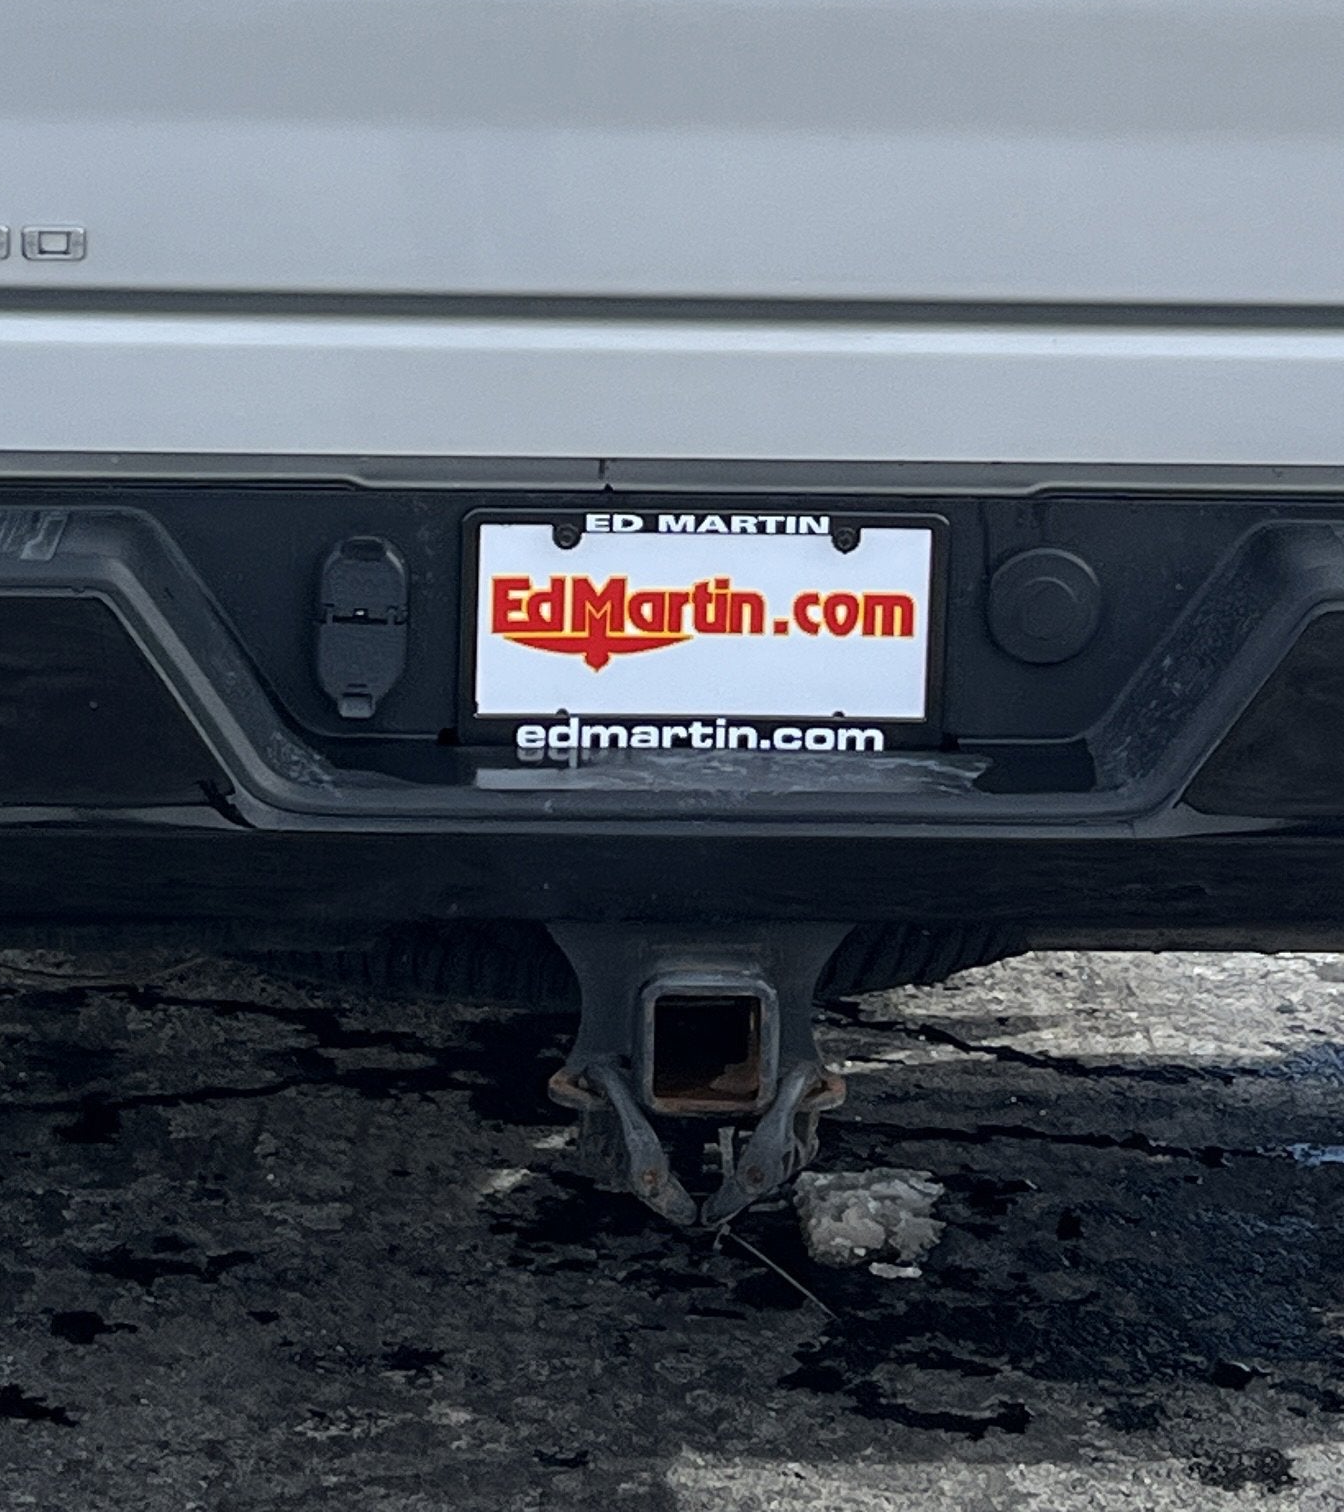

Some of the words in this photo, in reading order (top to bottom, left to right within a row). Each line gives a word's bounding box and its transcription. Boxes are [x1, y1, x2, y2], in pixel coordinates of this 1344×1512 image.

[586, 513, 643, 534] ED
[658, 514, 830, 535] MARTIN
[490, 575, 915, 638] EdMartin.com
[516, 718, 884, 752] edmartin.com
